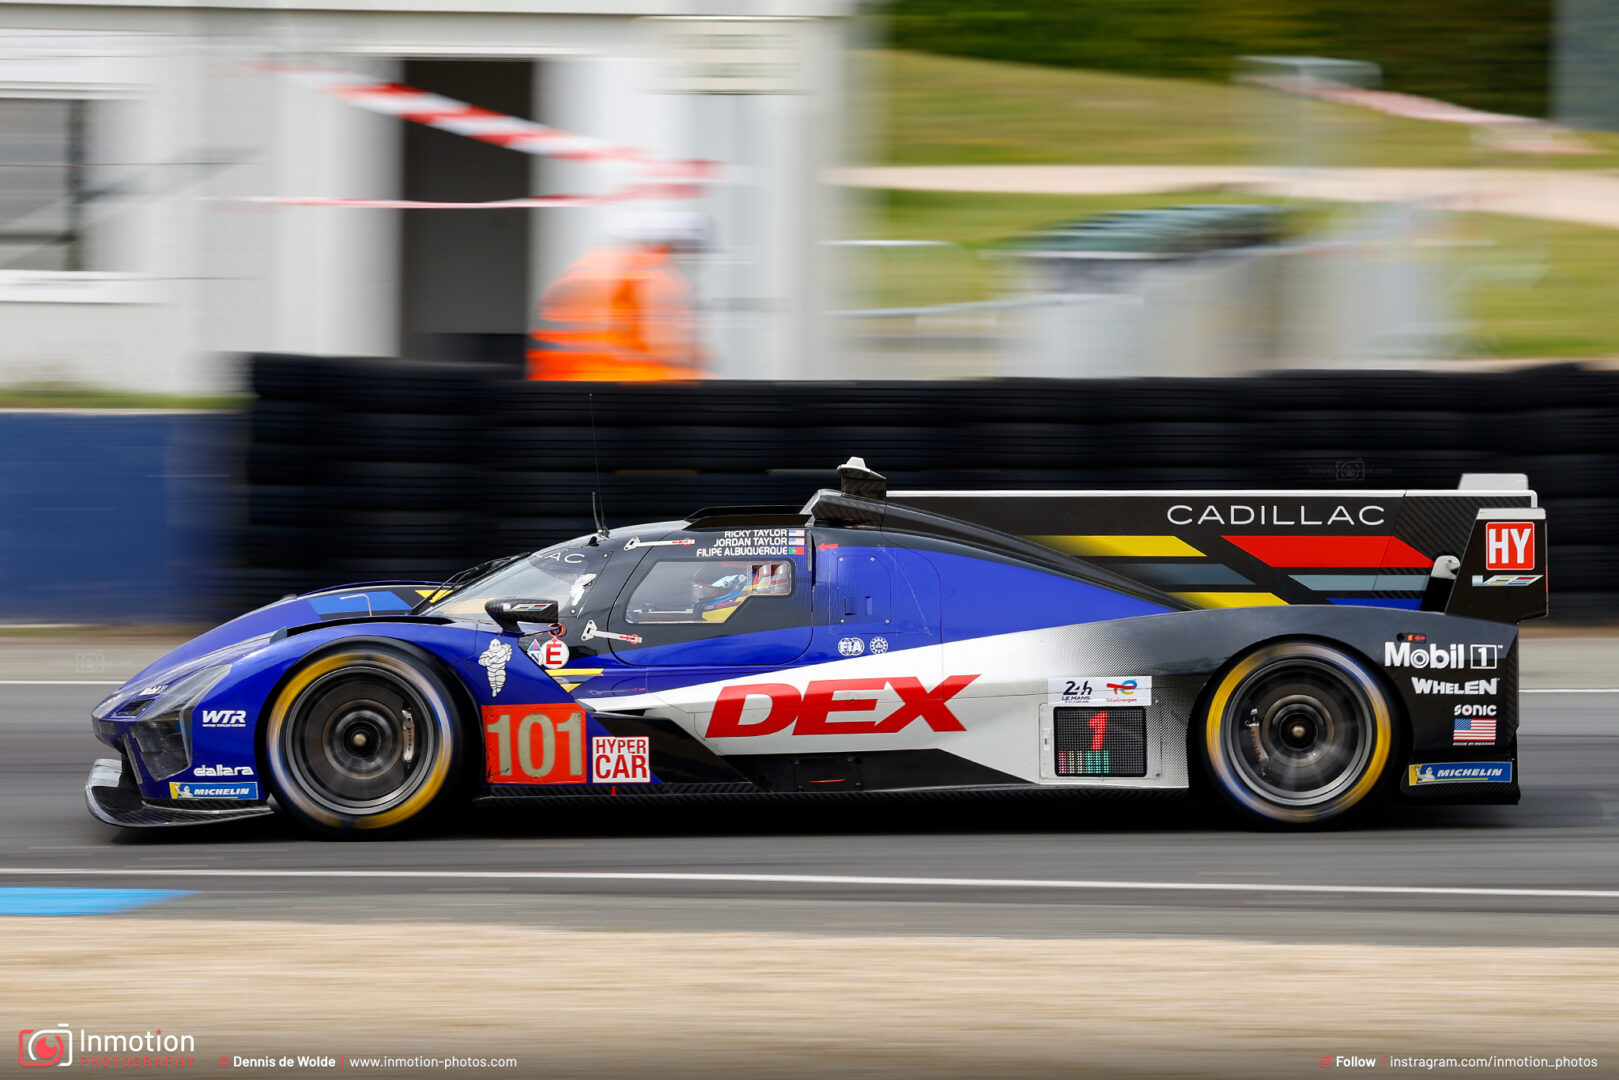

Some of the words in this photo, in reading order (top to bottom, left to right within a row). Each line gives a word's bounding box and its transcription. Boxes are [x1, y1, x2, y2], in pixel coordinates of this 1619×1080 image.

[1166, 505, 1385, 526] CADILLAC
[724, 530, 750, 538] RICKY
[753, 529, 787, 537] TAYLOR
[696, 548, 722, 557] FILIPE
[724, 547, 787, 556] ALBUQUERQUE
[714, 539, 750, 547] JORDAN
[1488, 528, 1531, 564] HY
[546, 644, 562, 664] E
[1384, 642, 1464, 669] Mobil
[1411, 677, 1497, 695] WHELEN
[704, 674, 981, 738] DEX
[202, 710, 246, 724] WTR
[1087, 711, 1108, 750] 1
[486, 711, 583, 777] 101
[596, 739, 646, 755] HYPER
[193, 765, 254, 776] dallara
[595, 754, 647, 779] CAR
[1436, 767, 1503, 777] MICHELIN
[194, 788, 249, 796] MICHELIN
